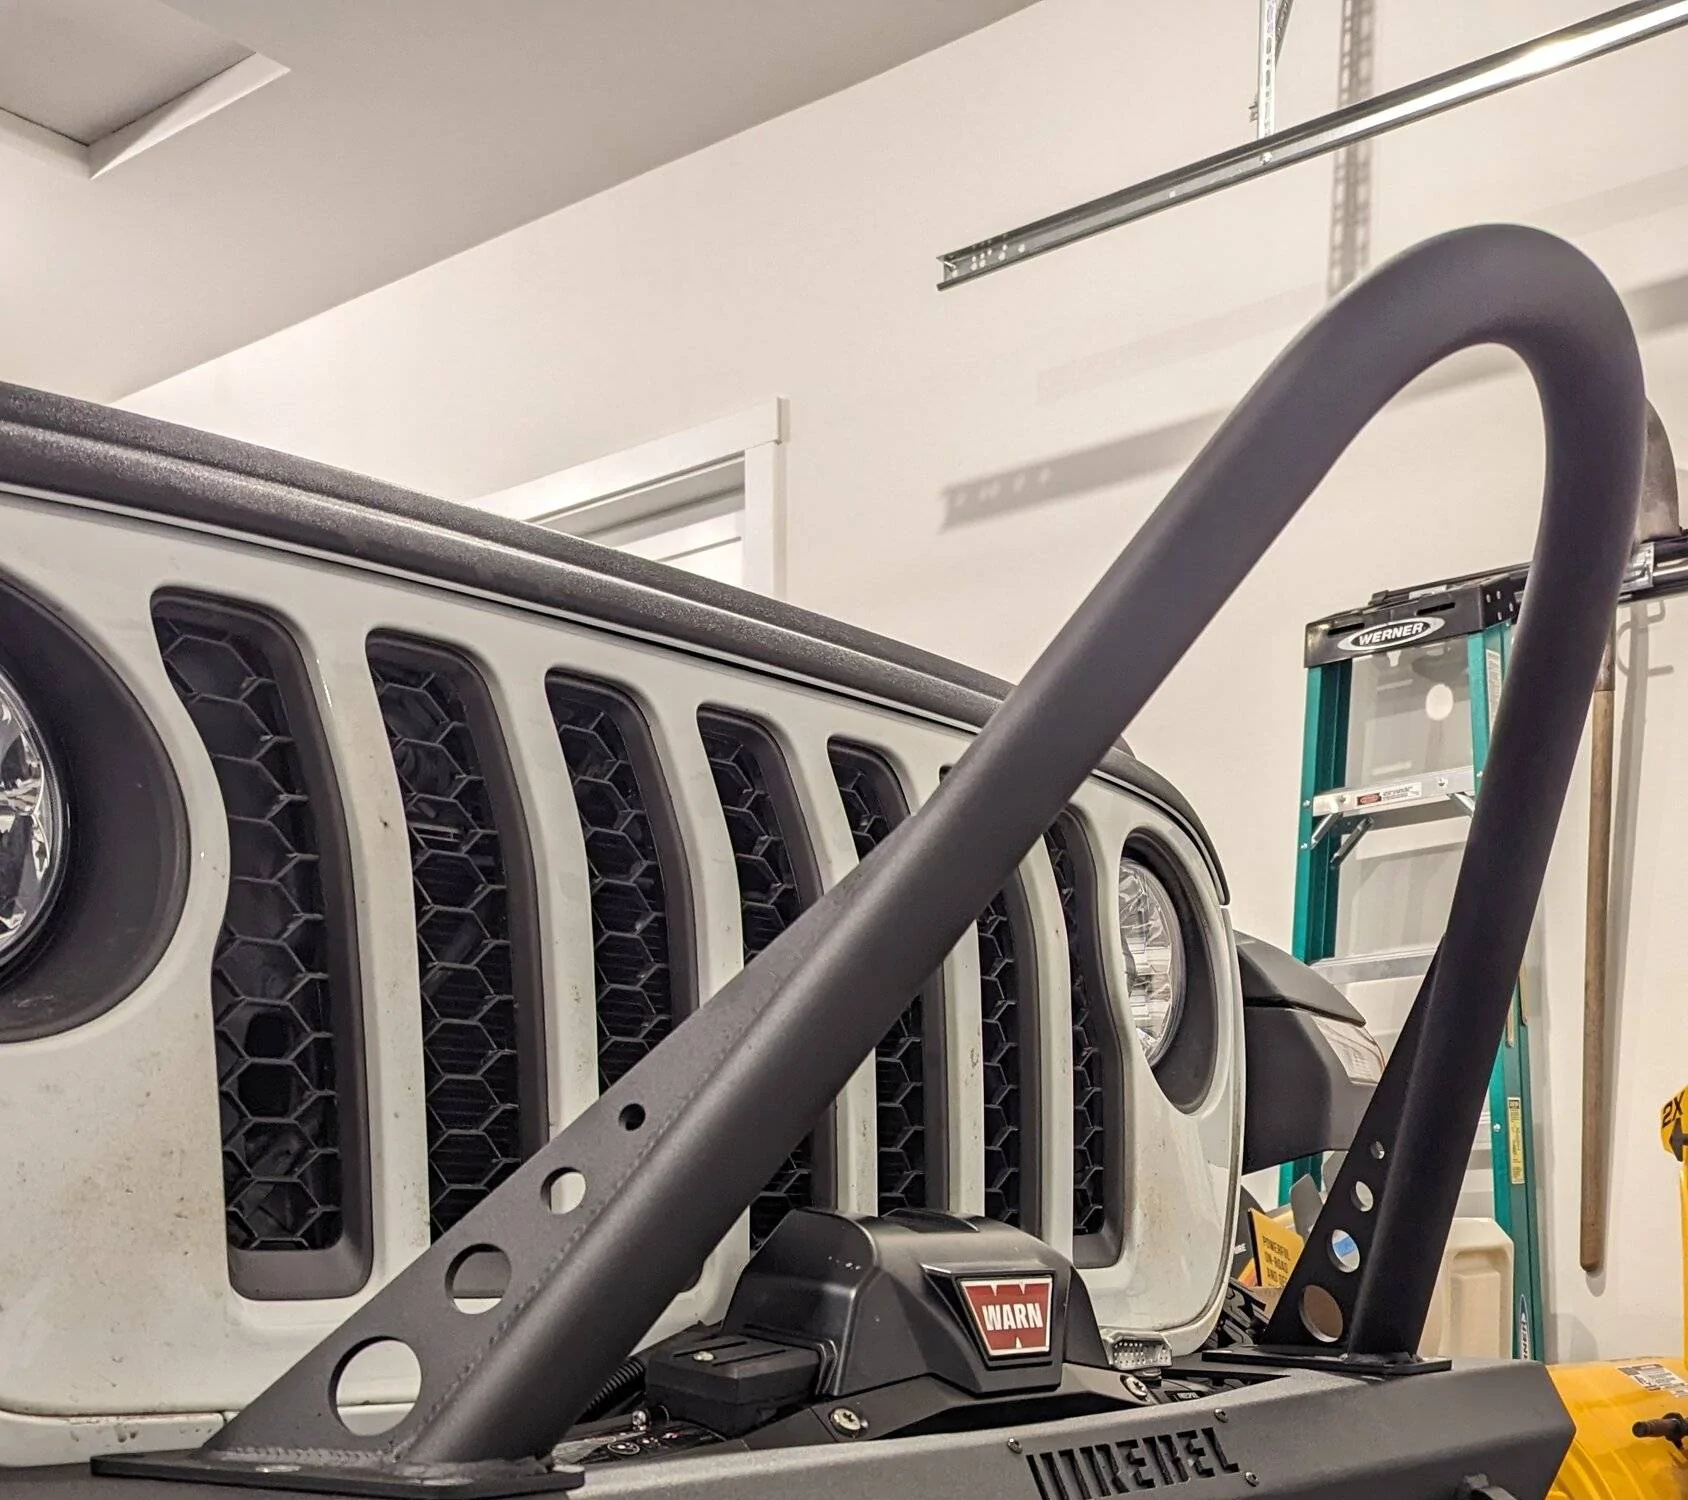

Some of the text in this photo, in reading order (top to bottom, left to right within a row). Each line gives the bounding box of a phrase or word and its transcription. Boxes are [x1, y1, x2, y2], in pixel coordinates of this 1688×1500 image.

[1360, 622, 1424, 646] WERNER
[1662, 1090, 1686, 1128] 2X
[981, 1303, 1043, 1331] WARN
[1080, 1427, 1240, 1497] REBEL
